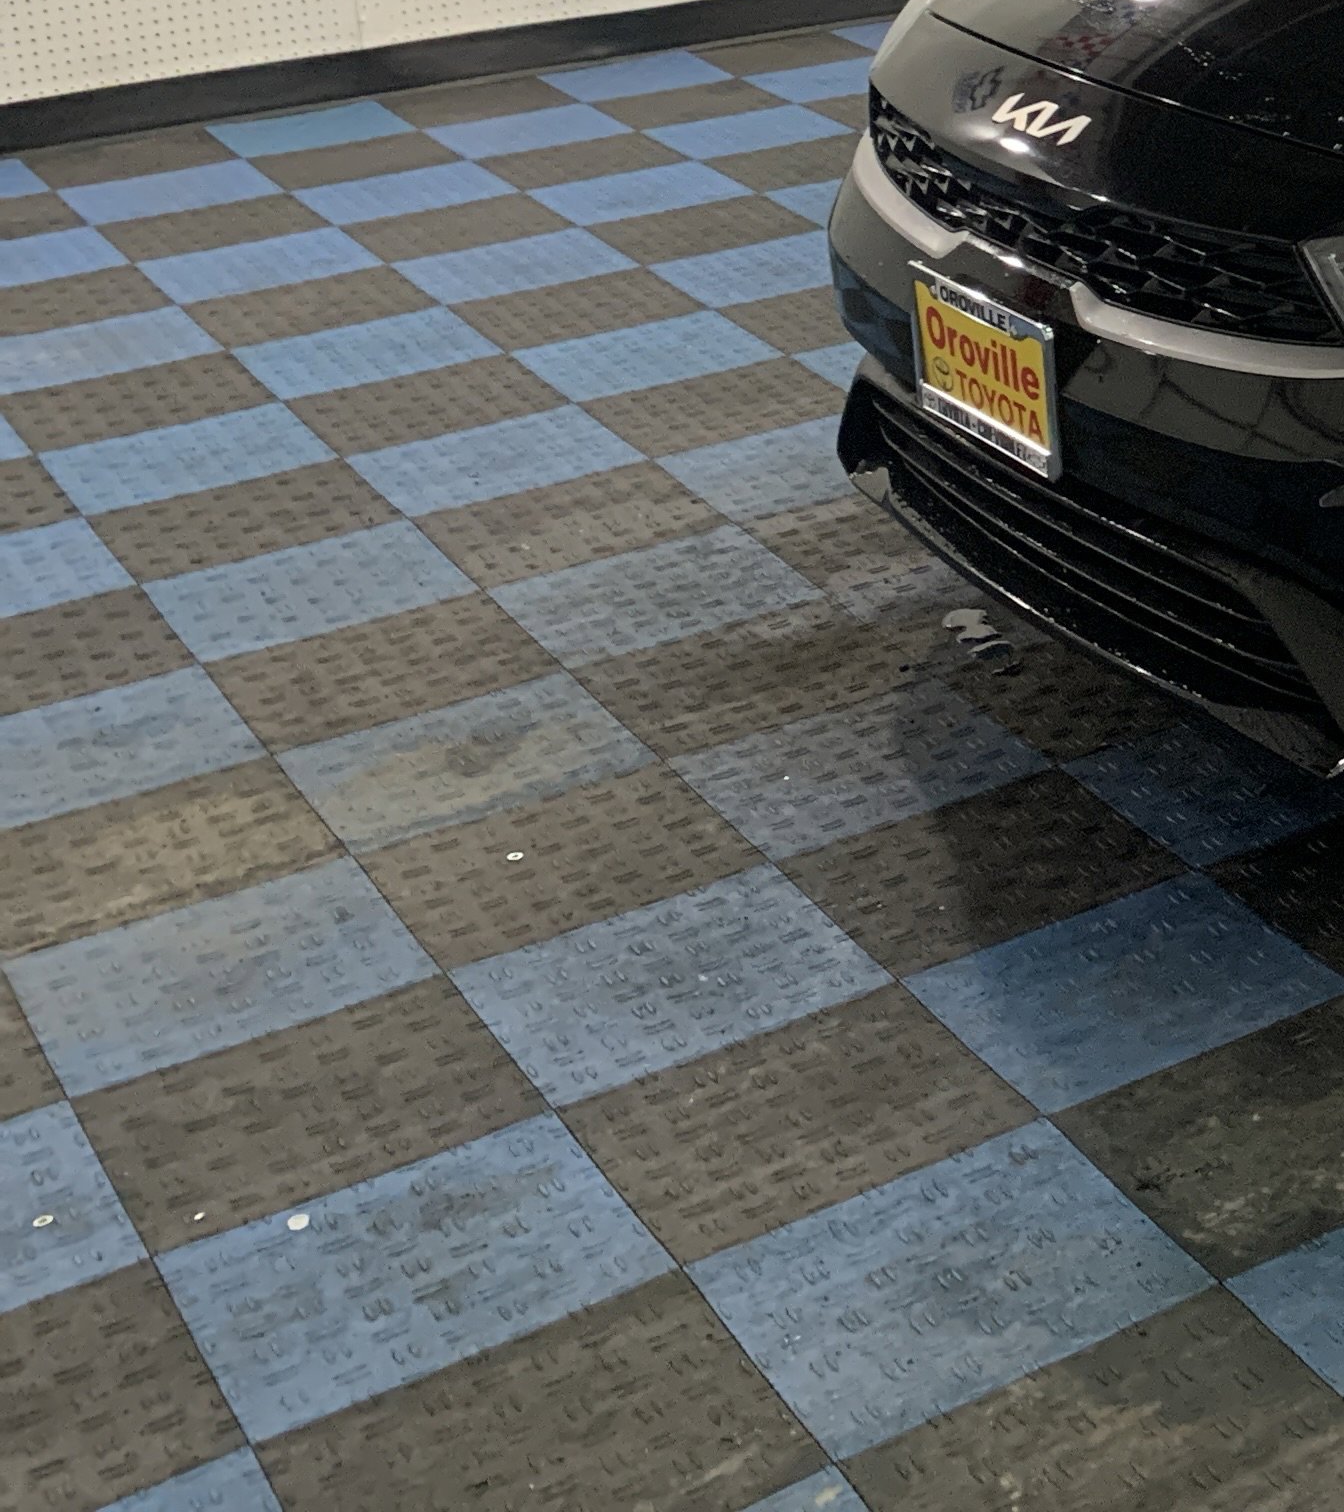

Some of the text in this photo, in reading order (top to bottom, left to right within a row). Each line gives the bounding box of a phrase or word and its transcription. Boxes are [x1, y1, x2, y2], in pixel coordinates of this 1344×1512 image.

[992, 92, 1092, 146] KIA
[940, 286, 1006, 331] OROVILLE
[926, 305, 1039, 400] Oroville
[955, 369, 1045, 444] TOYOTA
